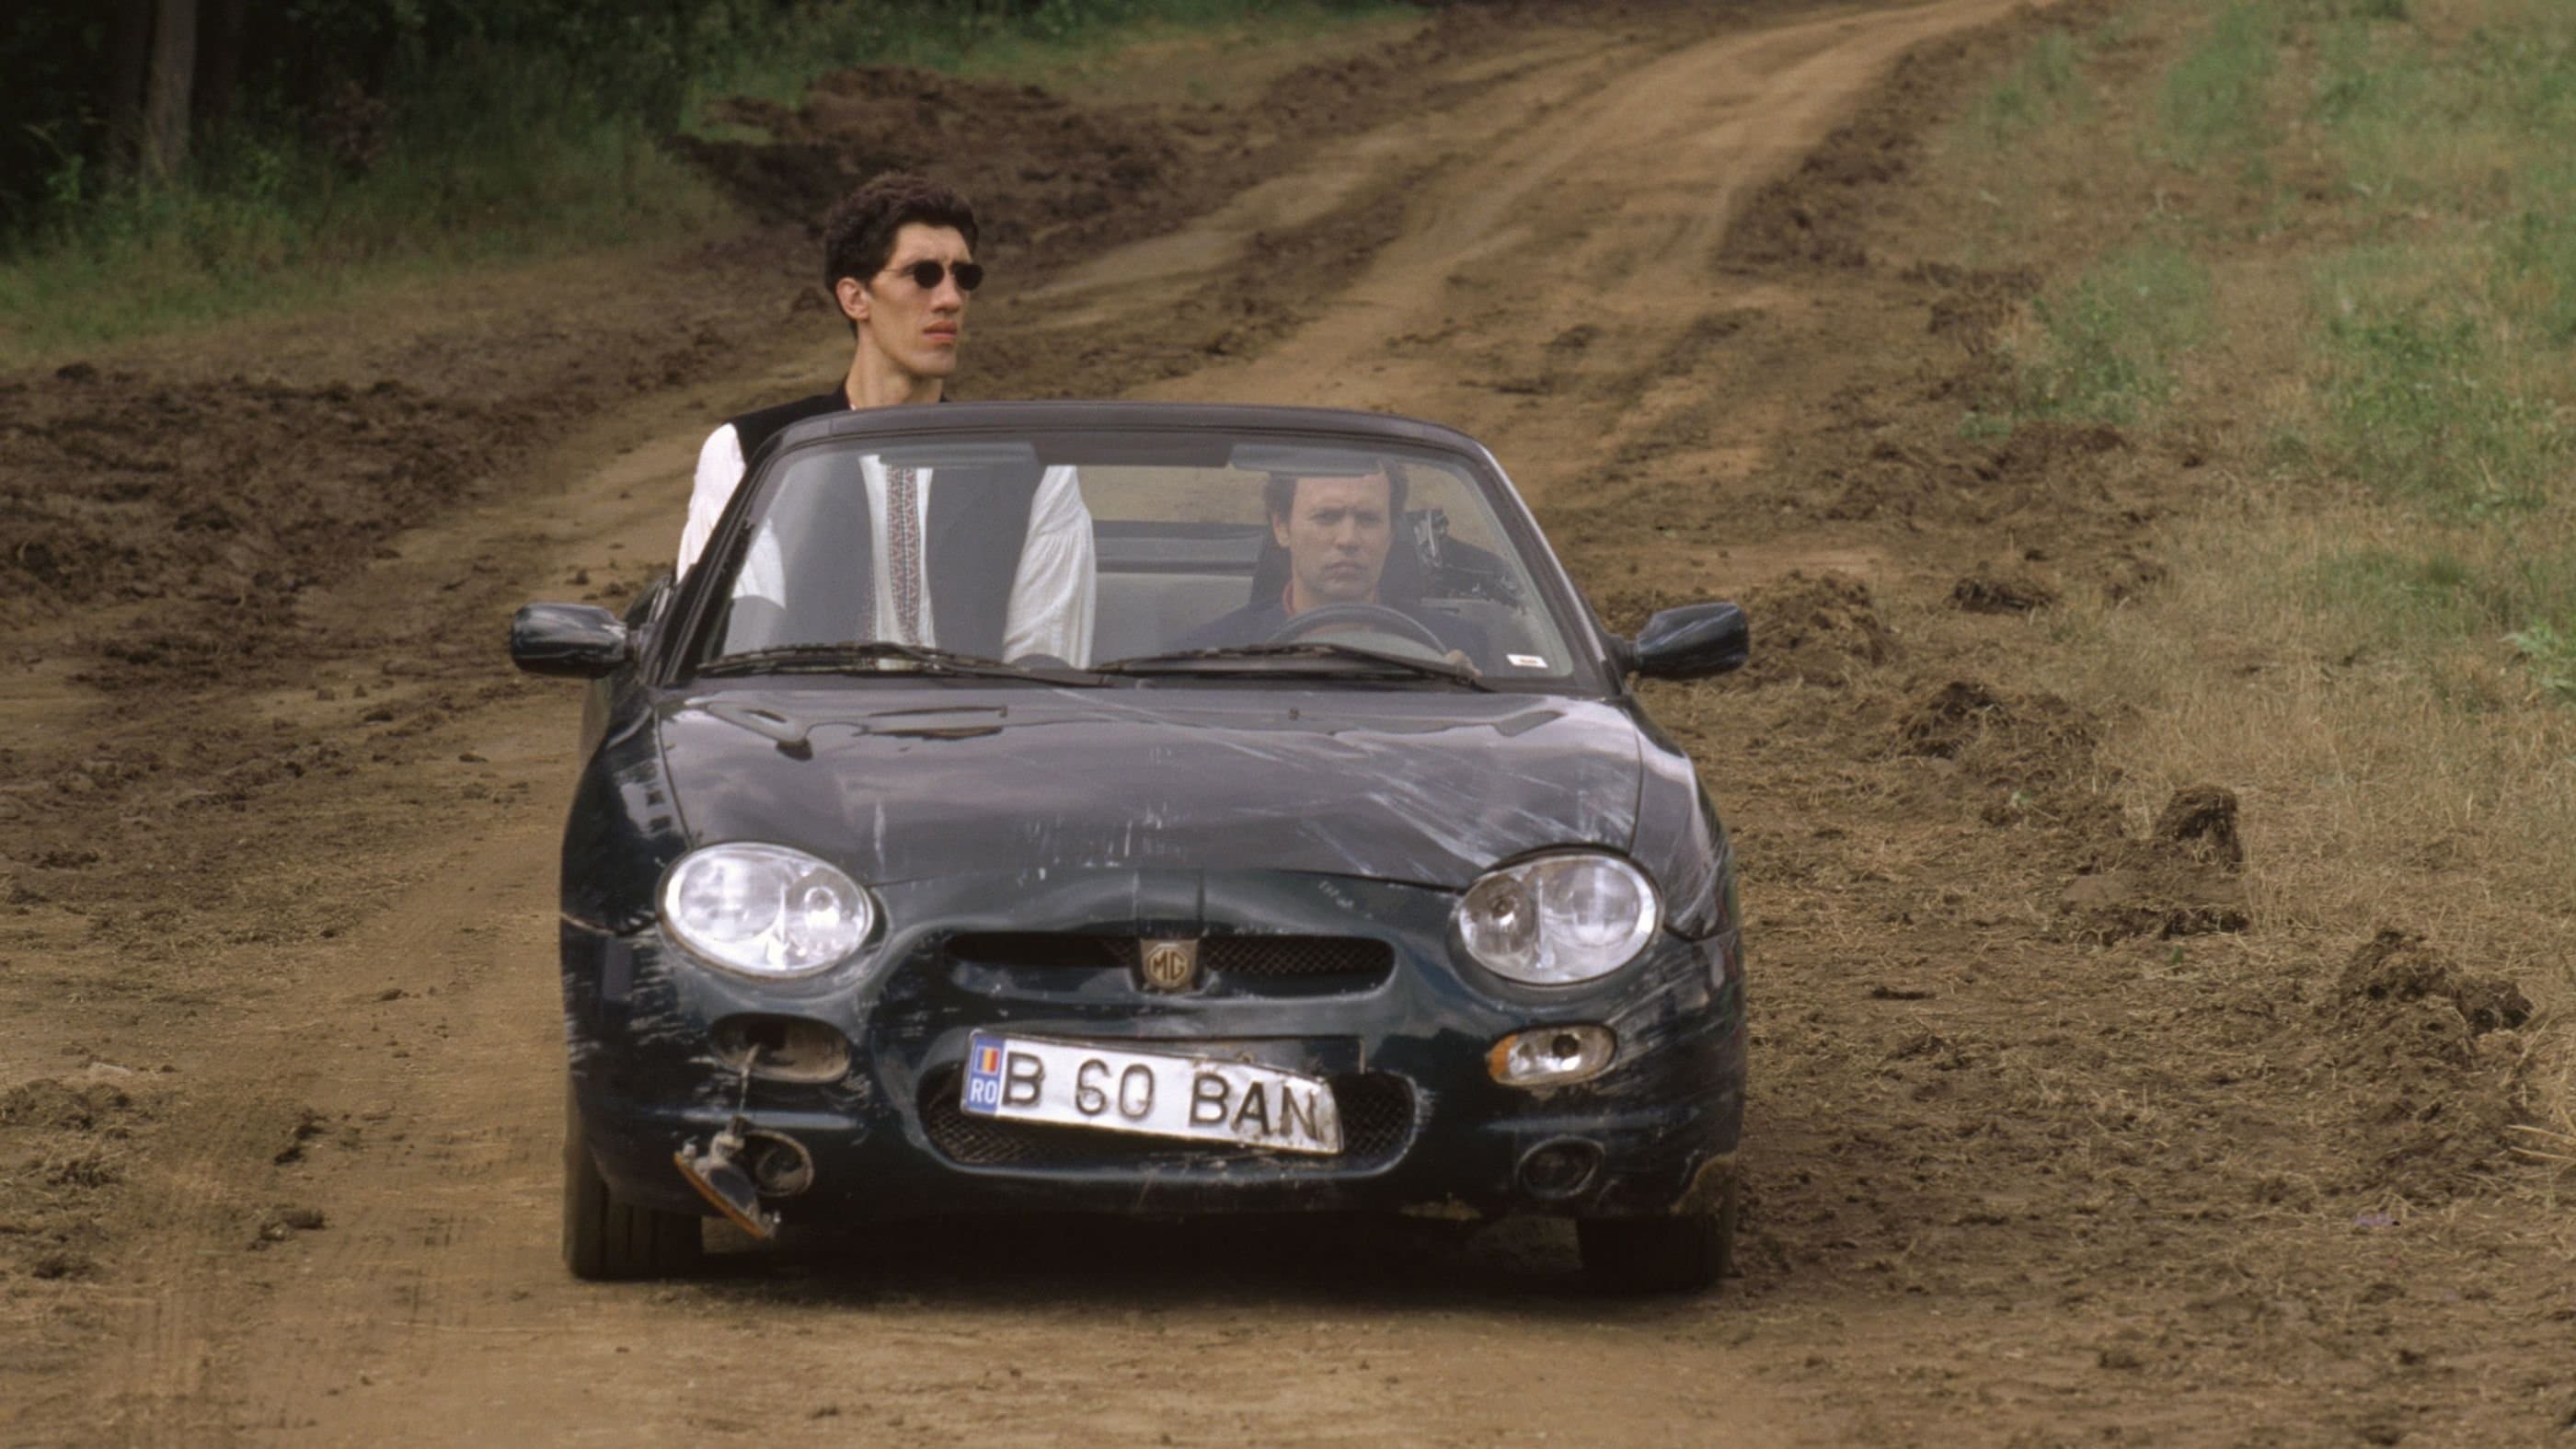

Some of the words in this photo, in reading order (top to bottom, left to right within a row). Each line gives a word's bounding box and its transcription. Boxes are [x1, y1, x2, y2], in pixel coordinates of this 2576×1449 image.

[1154, 949, 1186, 981] MG
[970, 1078, 996, 1104] RO
[1003, 1052, 1044, 1108] B
[1075, 1058, 1156, 1121] 60
[1189, 1072, 1321, 1142] BAN
